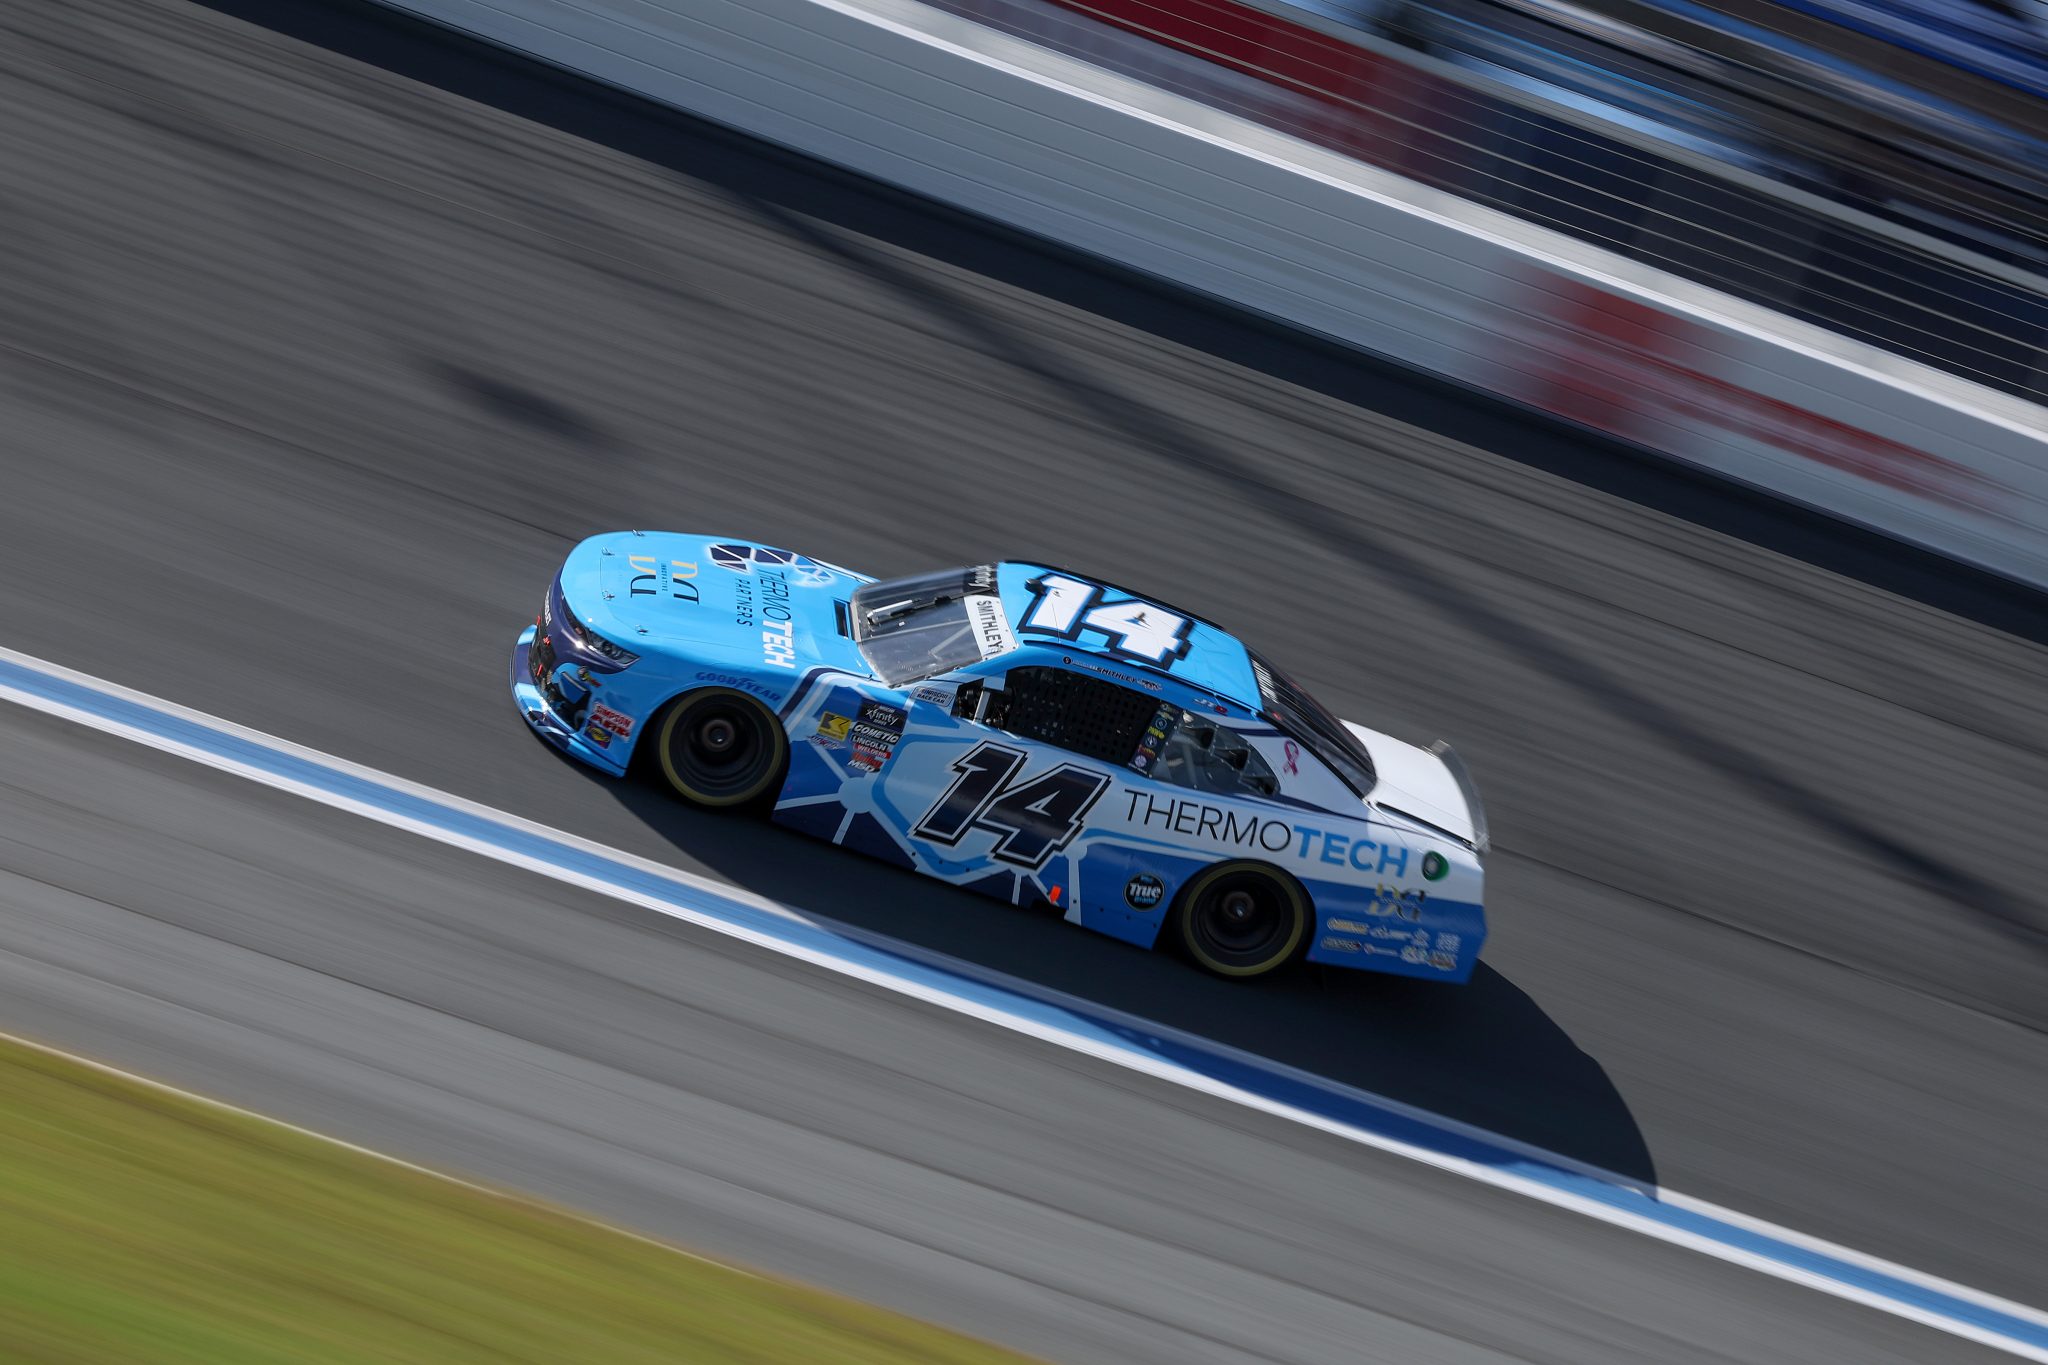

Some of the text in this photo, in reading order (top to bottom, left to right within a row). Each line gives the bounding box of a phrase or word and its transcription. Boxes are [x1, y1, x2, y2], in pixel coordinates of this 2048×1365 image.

[735, 577, 753, 627] PARTNERS
[757, 568, 796, 669] THERMOTECH
[976, 600, 1003, 649] SMITHLEY
[1017, 572, 1194, 670] 14
[696, 672, 781, 700] GOODYEAR
[865, 708, 899, 726] xfinity
[848, 759, 875, 772] MSD
[914, 740, 1111, 870] 14
[1124, 788, 1408, 878] THERMOTECH
[1130, 882, 1161, 899] True
